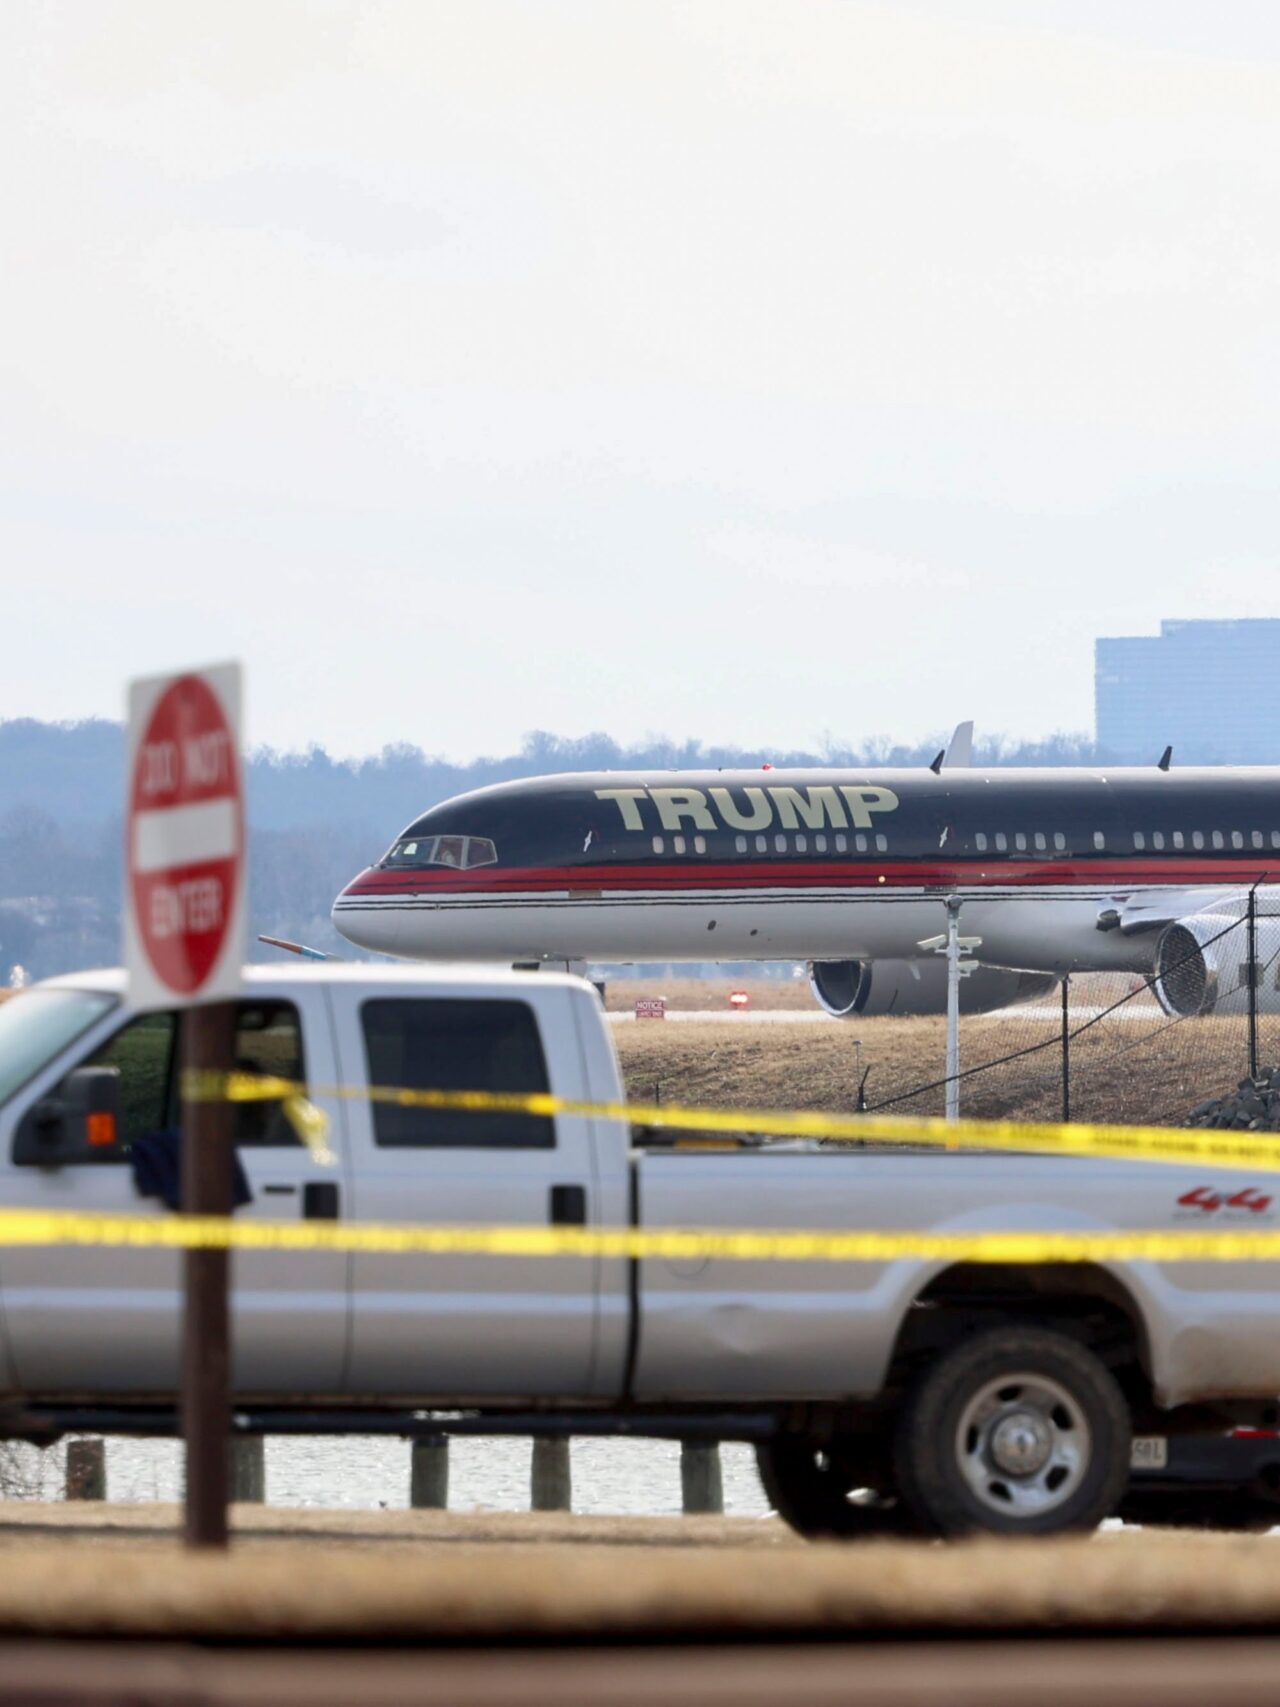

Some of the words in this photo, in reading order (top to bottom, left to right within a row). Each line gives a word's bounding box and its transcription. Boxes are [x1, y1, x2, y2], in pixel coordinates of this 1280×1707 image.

[594, 786, 899, 830] TRUMP
[150, 876, 223, 938] ENTER
[636, 1001, 663, 1009] NOTICE
